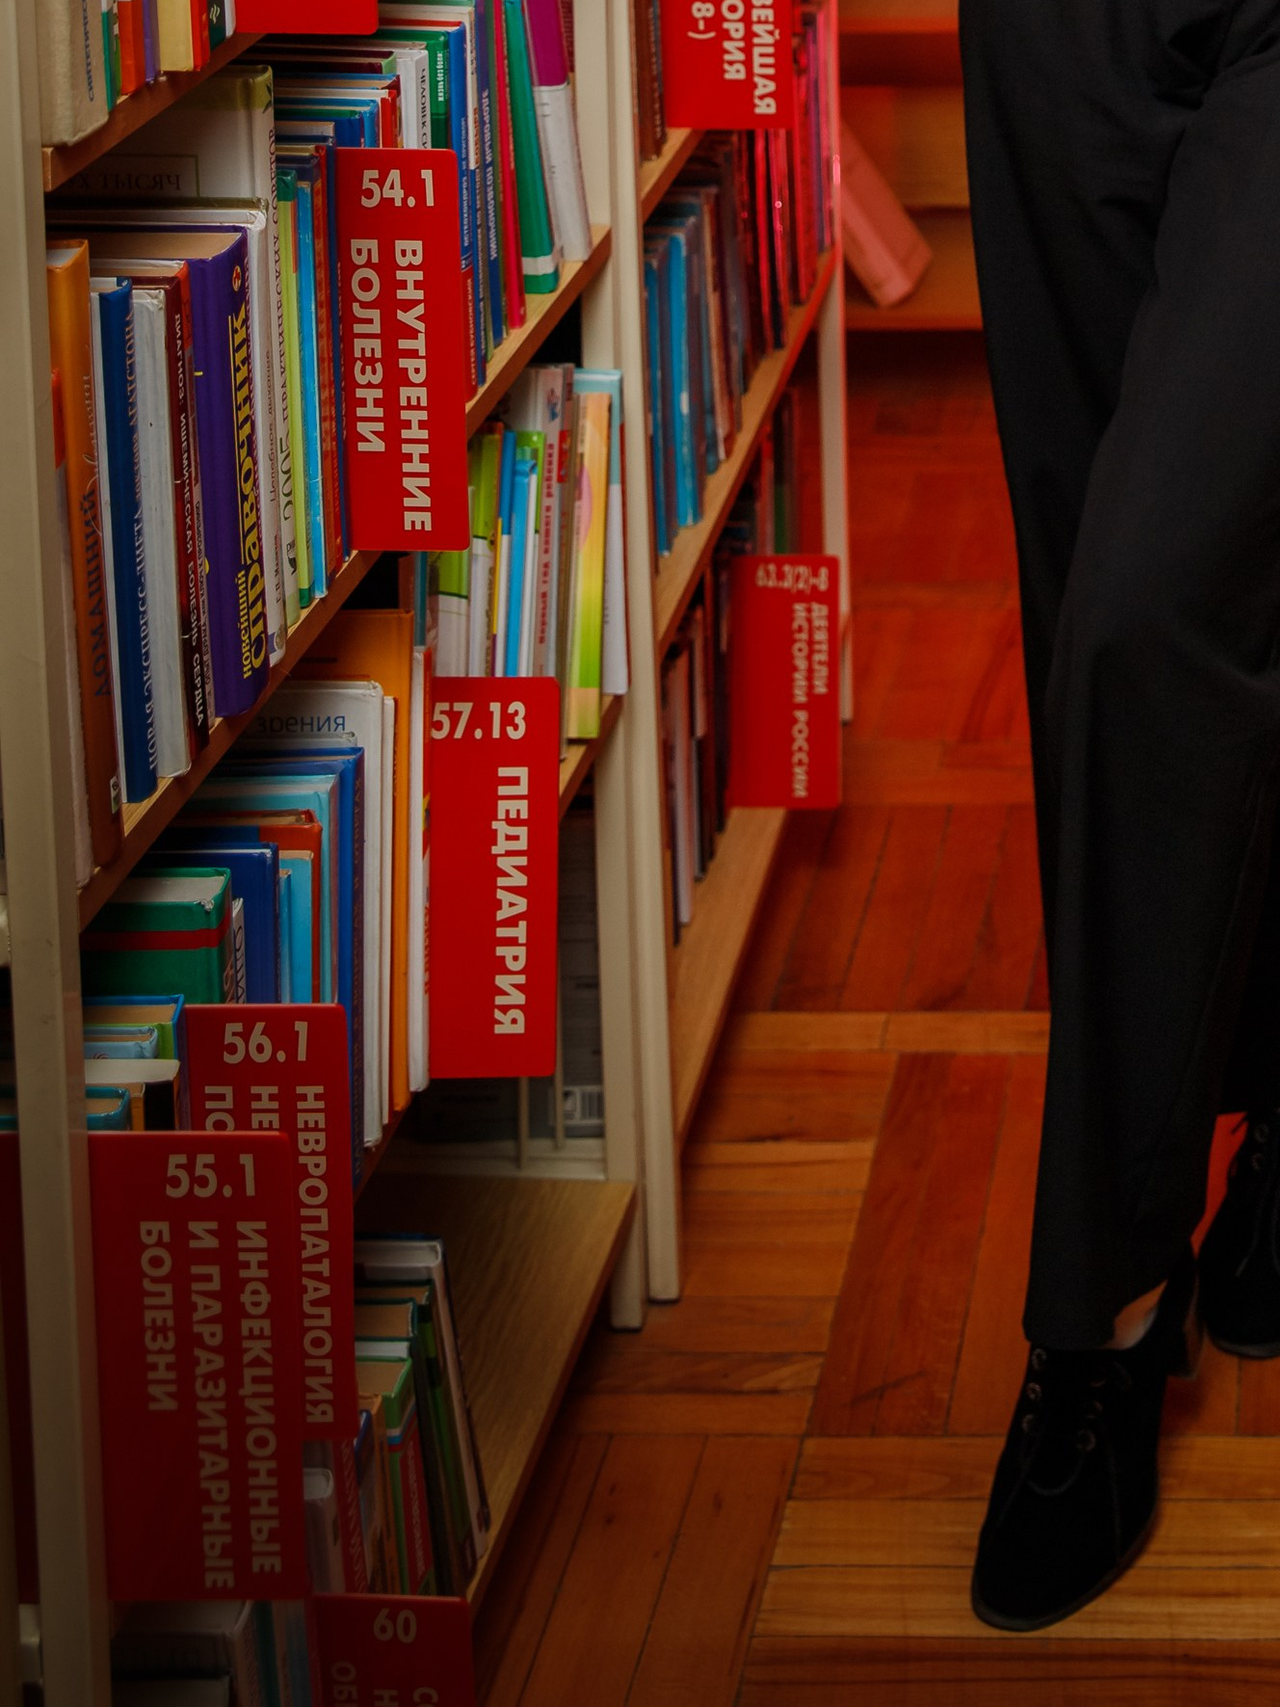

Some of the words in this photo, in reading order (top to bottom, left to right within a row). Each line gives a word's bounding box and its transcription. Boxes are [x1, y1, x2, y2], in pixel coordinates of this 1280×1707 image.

[481, 89, 493, 164] ЗДОРОВЫЙ
[360, 169, 435, 208] 54.1
[485, 168, 498, 260] ПОЗВОНОЧНИК
[174, 314, 185, 405] ДИАГНОЗ:
[350, 238, 386, 452] БОЛЕЗНИ
[394, 239, 432, 532] ВНУТРЕННИЕ
[179, 413, 194, 554] ИШЕМИЧЕСКАЯ
[232, 312, 266, 665] справочник
[77, 487, 111, 697] ДОМАШНИЙ
[187, 562, 199, 647] БОЛЕЗНЬ
[235, 569, 252, 678] новейший
[192, 656, 204, 726] СЕРДЦА
[810, 601, 829, 695] ДЕЯТЕЛИ
[430, 700, 526, 740] 57.13
[791, 709, 809, 798] РОССИИ
[491, 766, 529, 1034] ПЕДИАТРИЯ
[223, 1020, 309, 1064] 56.1
[165, 1153, 256, 1198] 55.1
[187, 1221, 220, 1249] И
[295, 1085, 334, 1423] НЕВРОПАТАЛОГИЯ
[139, 1220, 178, 1411] БОЛЕЗНИ
[189, 1264, 235, 1588] ПАРАЗИТАРНЫЕ
[235, 1220, 282, 1573] ИНФЕКЦИОННЫЕ
[373, 1607, 417, 1644] 60
